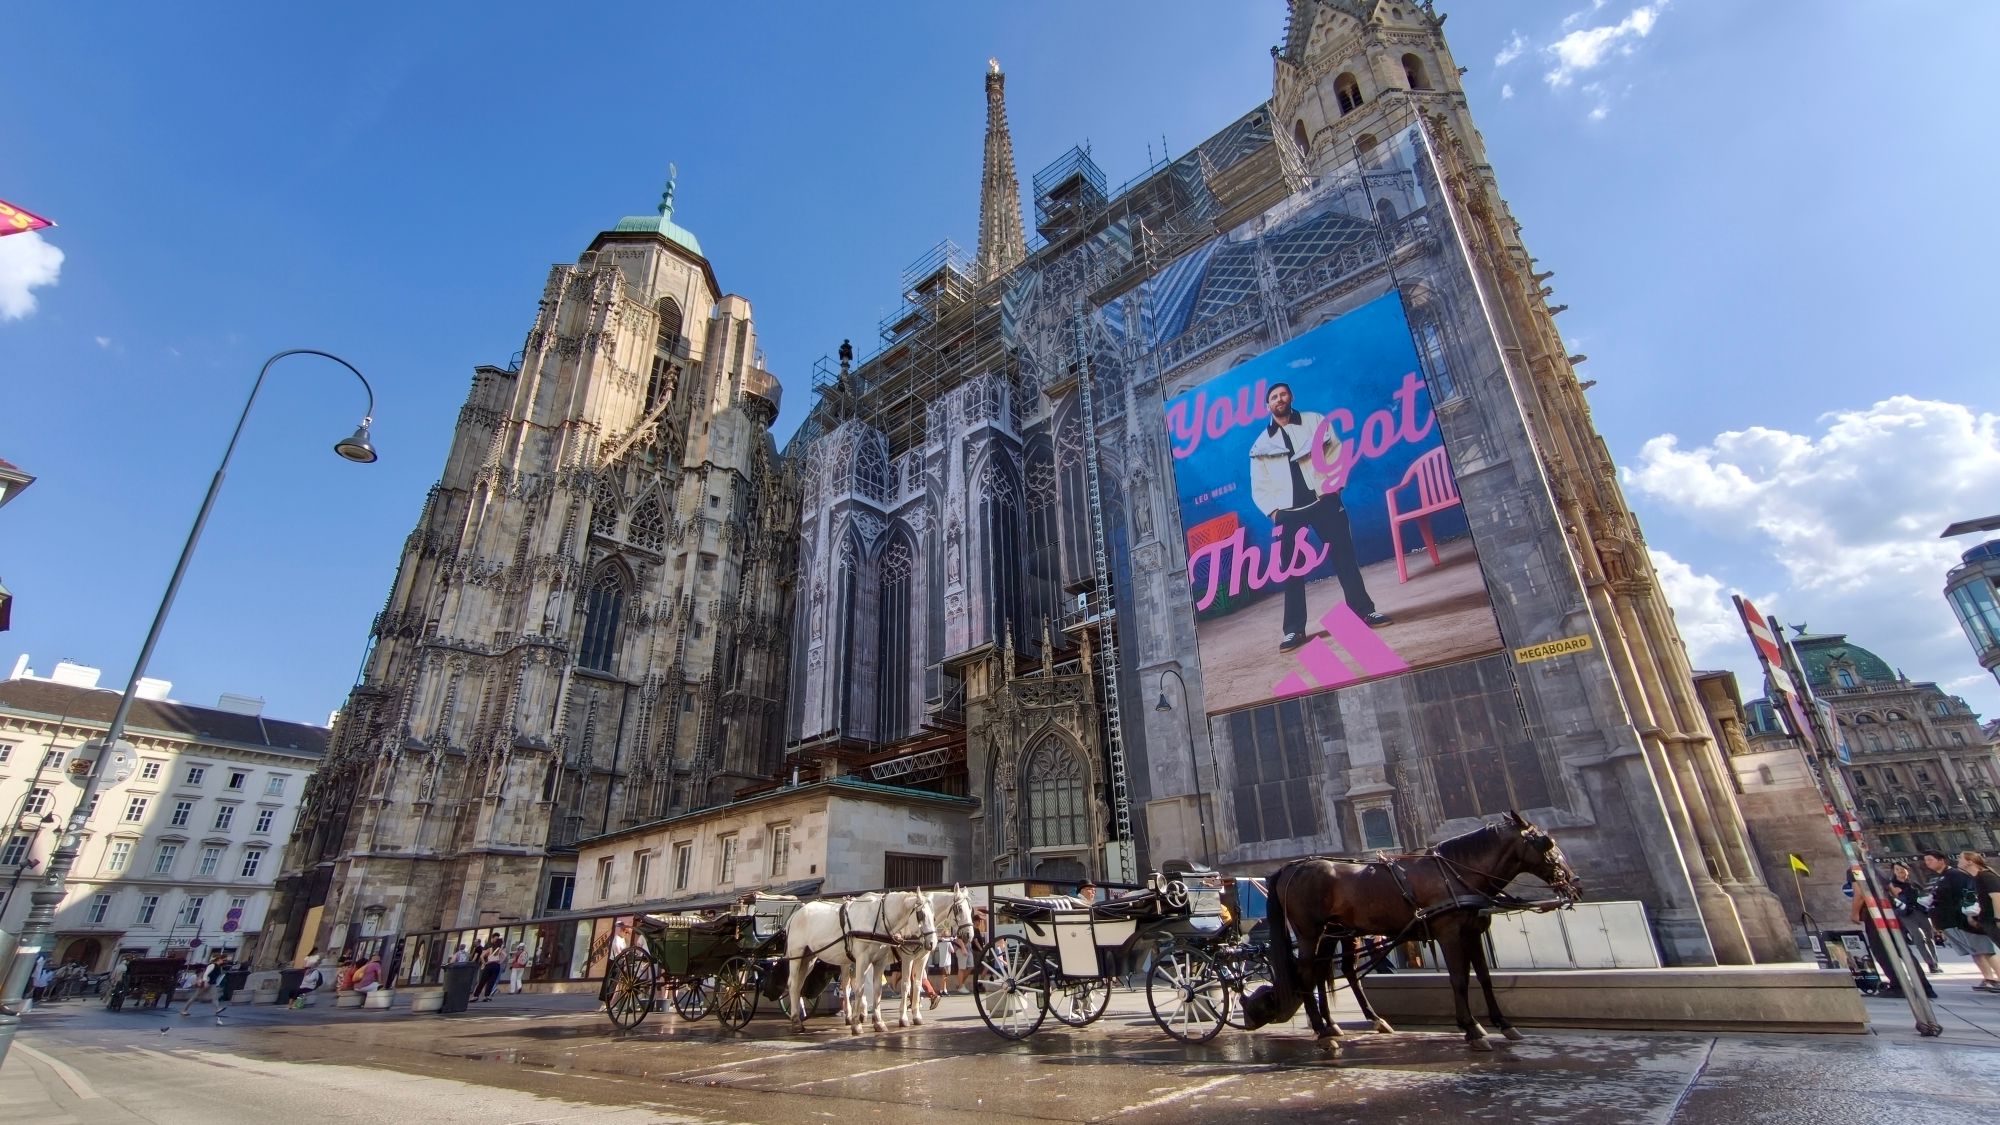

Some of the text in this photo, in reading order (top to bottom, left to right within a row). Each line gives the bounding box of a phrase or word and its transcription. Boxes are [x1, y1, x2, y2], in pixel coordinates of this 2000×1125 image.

[1166, 378, 1269, 459] You
[1311, 371, 1435, 494] Got
[1188, 524, 1330, 611] This
[1520, 639, 1587, 659] MEGABOARD
